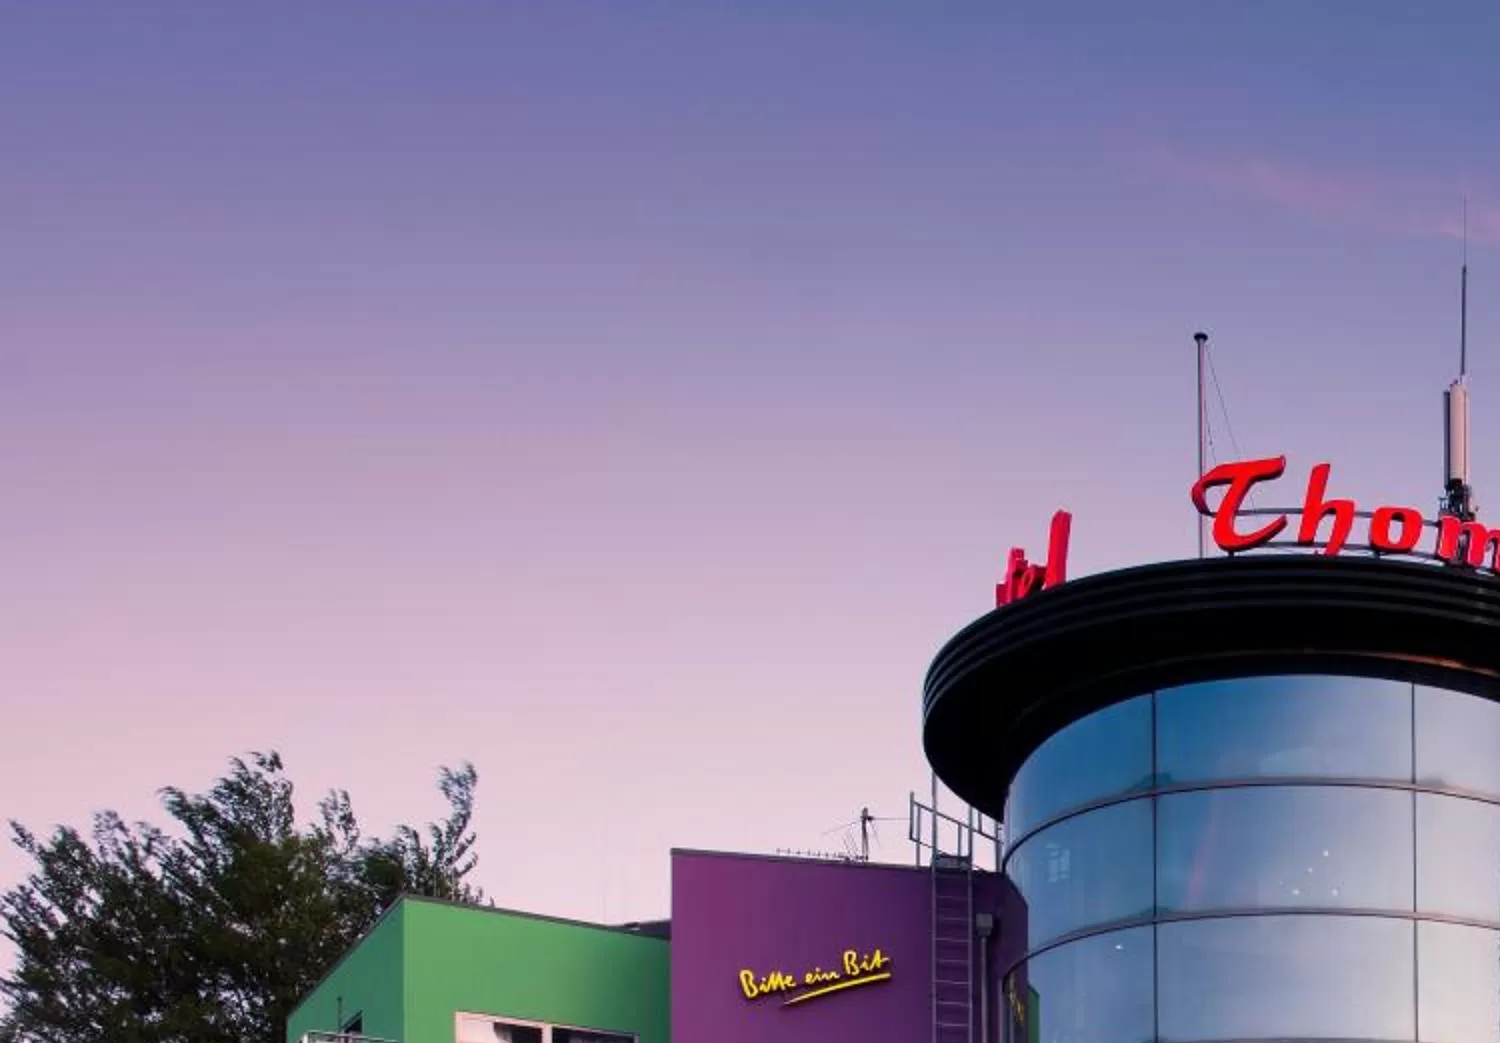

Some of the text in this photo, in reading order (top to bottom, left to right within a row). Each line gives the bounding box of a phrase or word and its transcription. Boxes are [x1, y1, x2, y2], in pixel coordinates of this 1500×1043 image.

[739, 949, 891, 999] Bitte ein Bit
